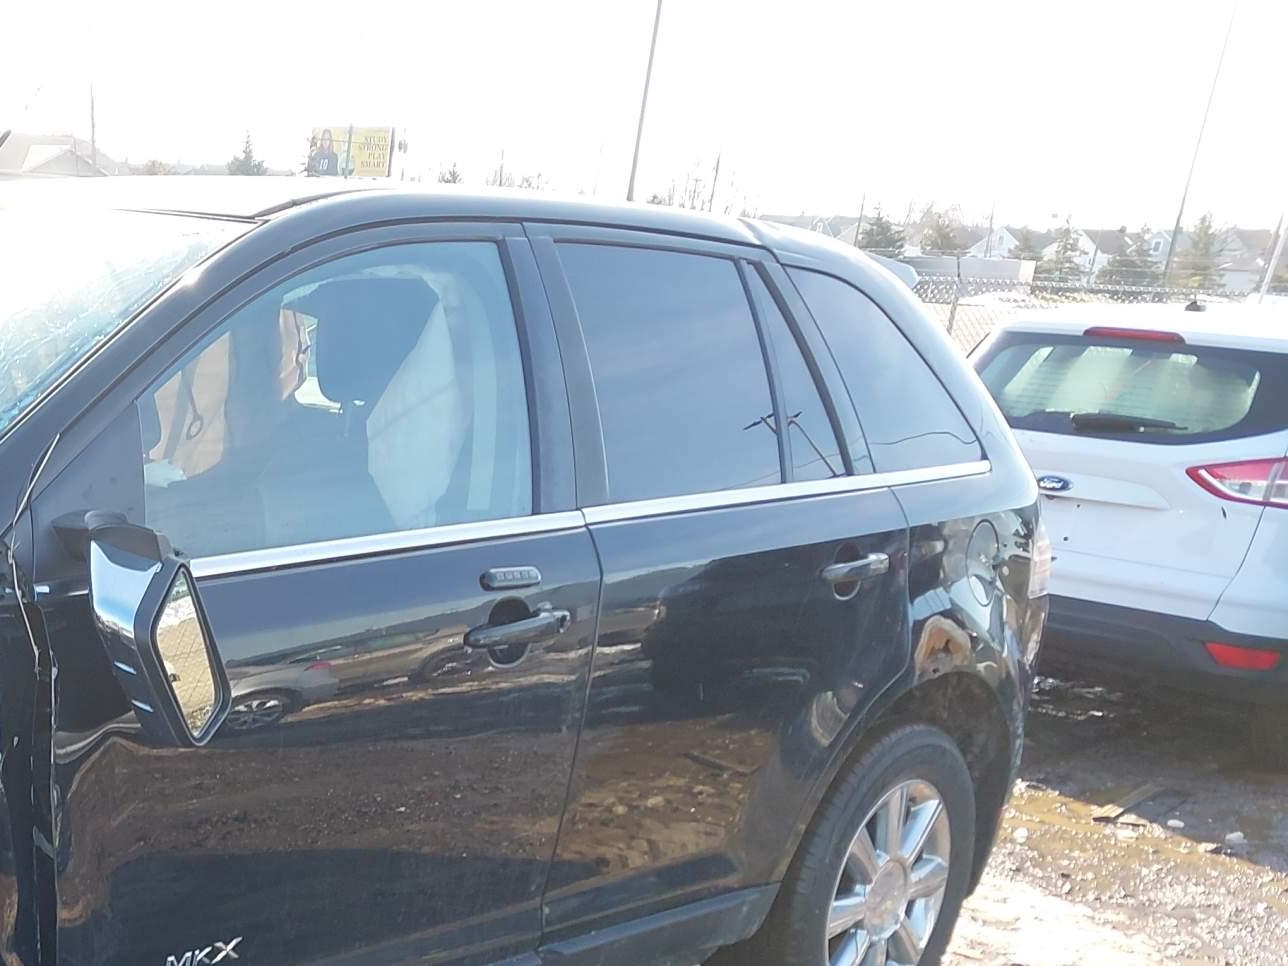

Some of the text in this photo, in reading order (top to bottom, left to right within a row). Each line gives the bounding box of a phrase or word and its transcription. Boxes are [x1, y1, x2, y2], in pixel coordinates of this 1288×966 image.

[368, 152, 385, 160] PLAY
[360, 160, 385, 168] SMART
[1039, 478, 1064, 489] Ford
